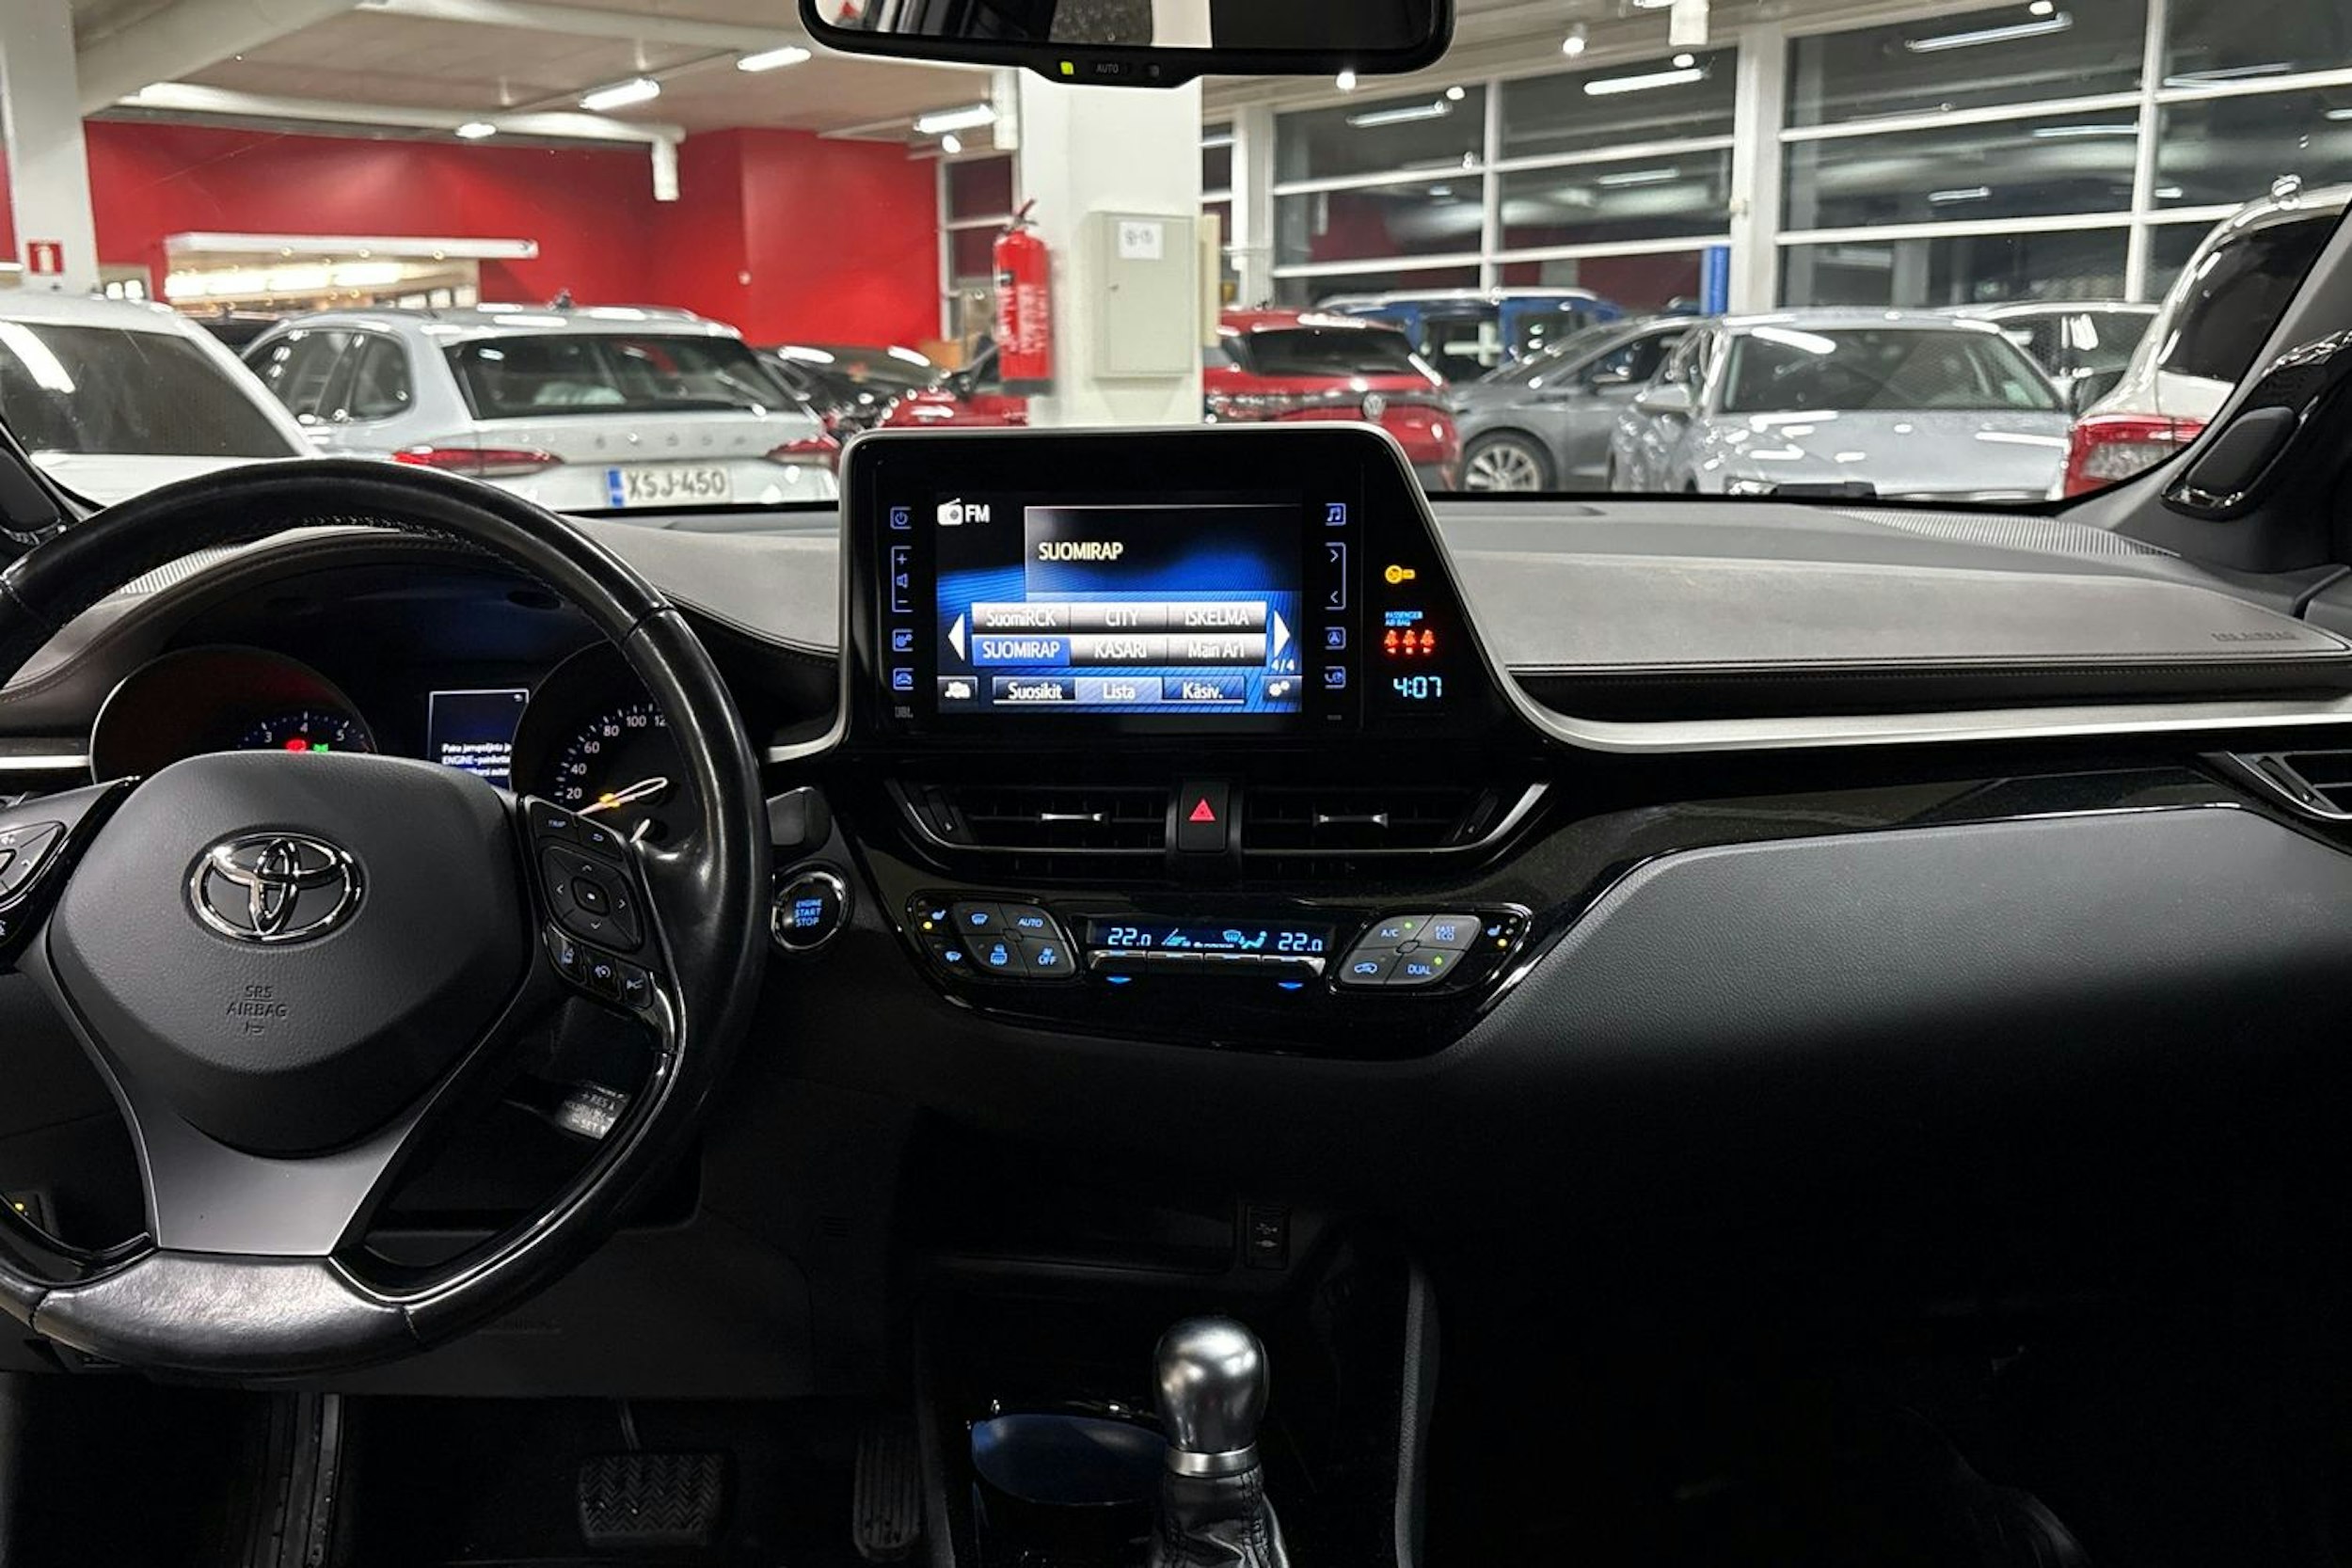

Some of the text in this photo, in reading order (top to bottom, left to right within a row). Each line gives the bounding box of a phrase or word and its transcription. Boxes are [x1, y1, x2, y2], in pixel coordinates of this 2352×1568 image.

[1096, 63, 1120, 74] AUTO
[628, 470, 726, 499] XSJ-450
[964, 504, 991, 523] FM
[1038, 541, 1124, 561] SUOMIRAP
[986, 610, 1057, 627] SuomiRCK
[1104, 610, 1139, 626] CITY
[982, 641, 1060, 658] SUOMIRAP
[1094, 641, 1148, 658] KASARI
[1187, 640, 1219, 658] Main
[1271, 659, 1295, 673] 4/4
[1008, 682, 1063, 700] Suosikit
[1103, 682, 1136, 700] Lista
[1182, 681, 1223, 700] Käsiv.
[1392, 675, 1442, 699] 4:07
[626, 715, 647, 727] 100
[654, 714, 666, 727] 12
[299, 721, 309, 734] 4
[602, 724, 620, 737] 80
[264, 731, 273, 743] 3
[336, 728, 345, 741] 5
[583, 740, 600, 754] 60
[570, 762, 587, 775] 40
[566, 787, 582, 800] 20
[795, 907, 822, 918] START
[795, 916, 819, 927] STOP
[1017, 916, 1044, 928] AUTO
[1107, 927, 1152, 946] 22.0
[1380, 927, 1399, 938] A/C
[1435, 932, 1455, 941] ECO
[1277, 931, 1324, 952] 22.0
[1037, 955, 1057, 966] OFF
[1406, 963, 1432, 975] DUAL
[245, 985, 274, 998] SRS
[226, 1001, 288, 1017] AIRBAG
